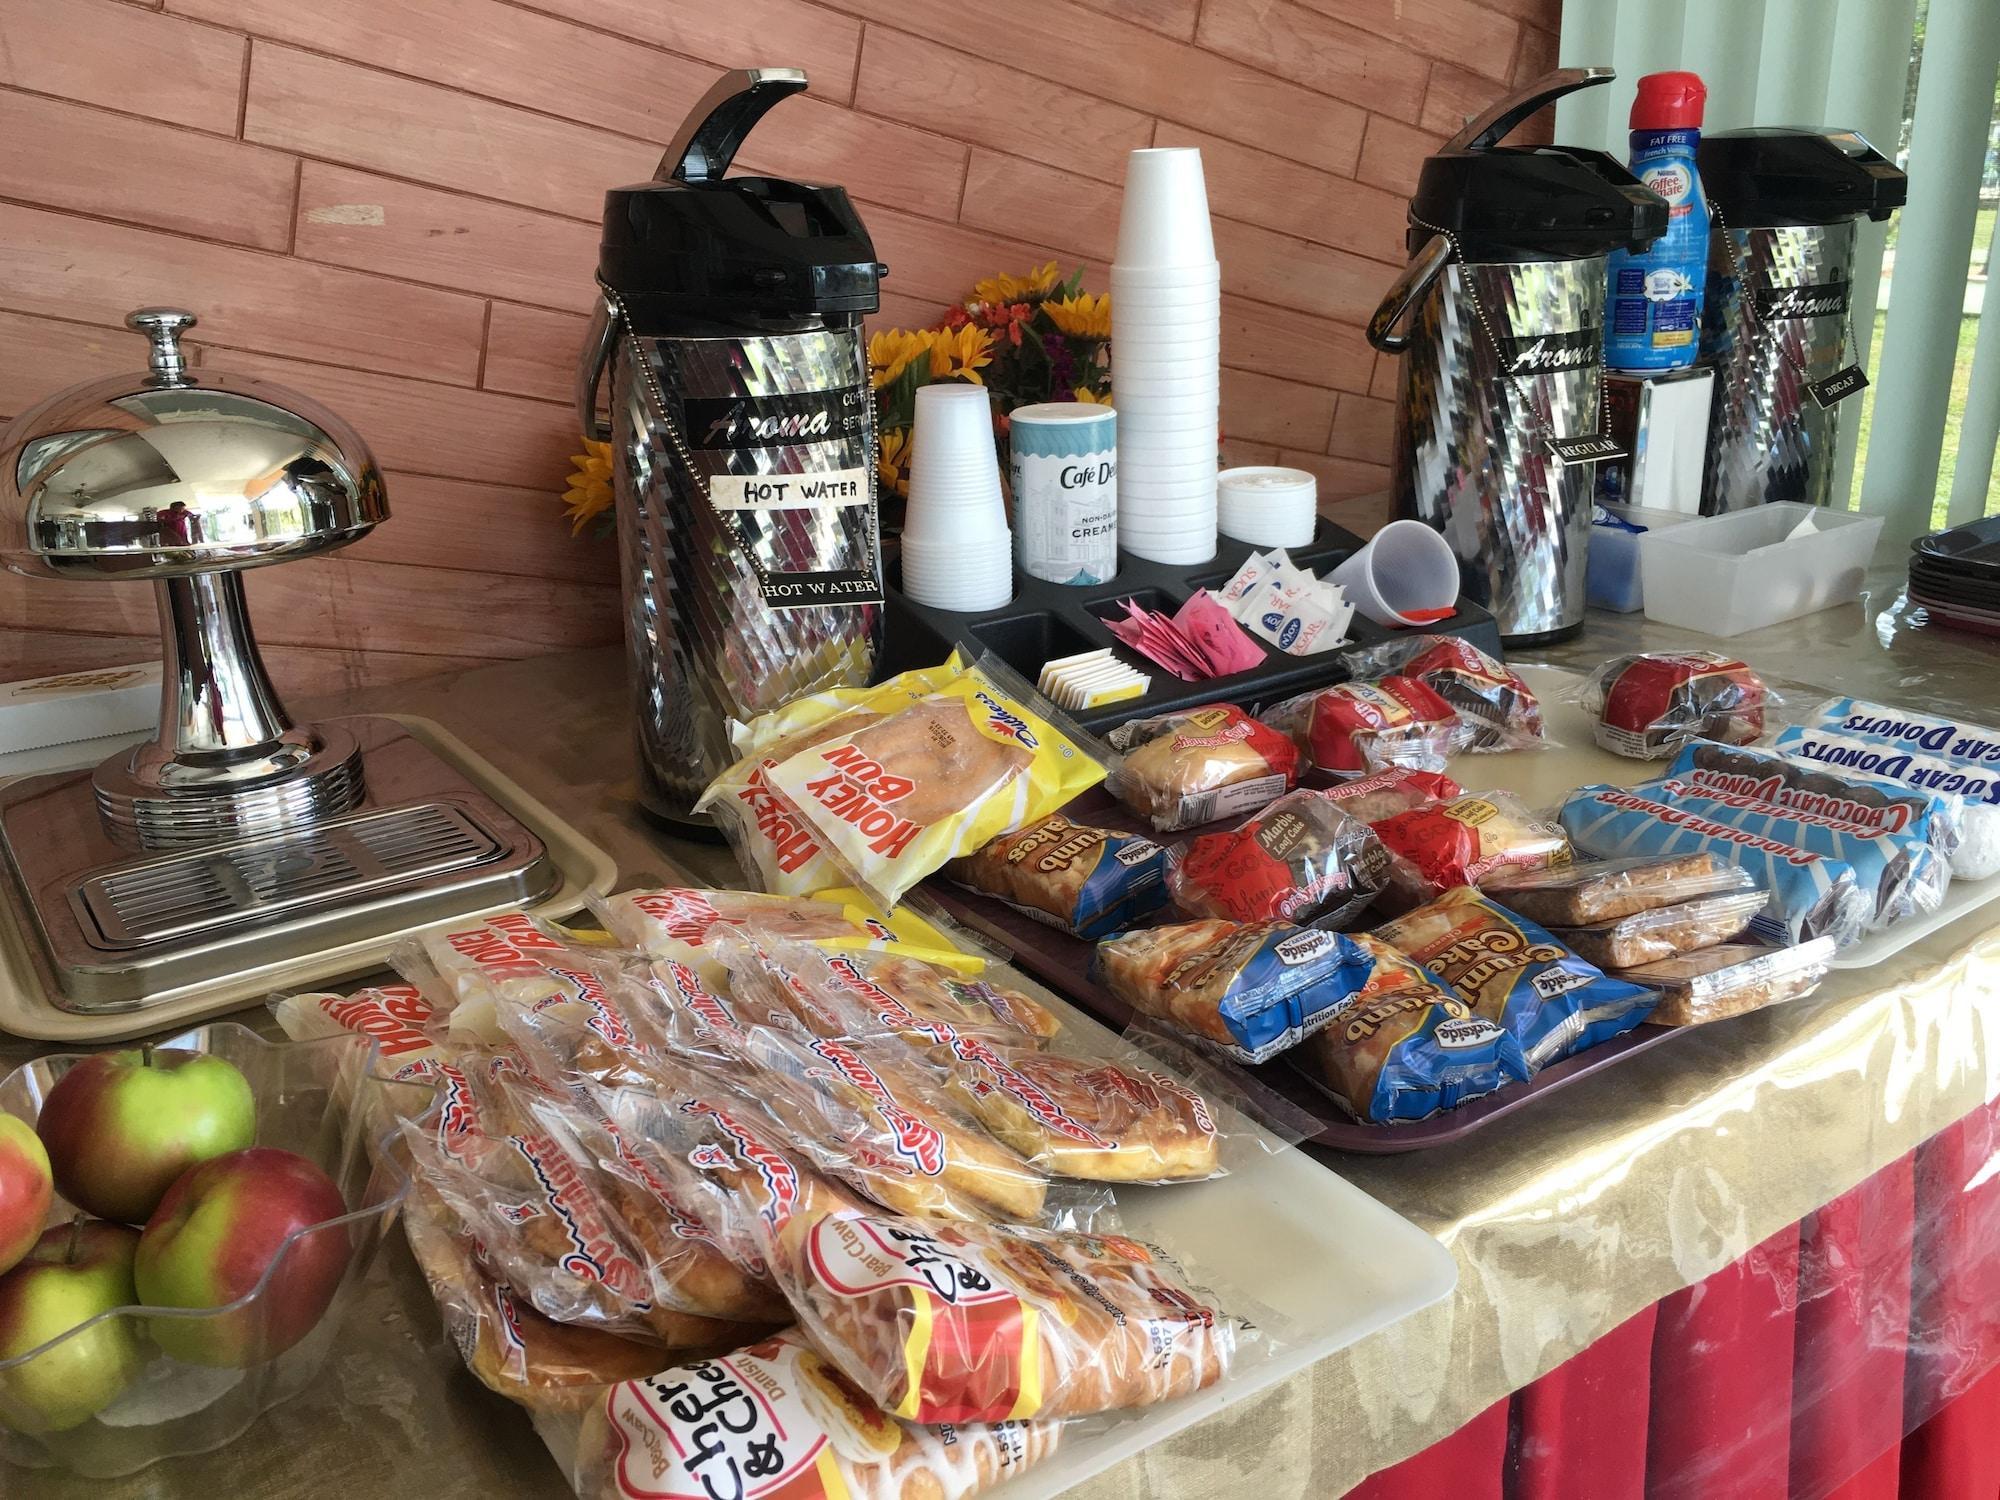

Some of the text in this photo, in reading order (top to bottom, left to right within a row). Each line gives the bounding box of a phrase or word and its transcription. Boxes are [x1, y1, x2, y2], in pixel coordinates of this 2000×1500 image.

[1650, 135, 1687, 147] FAT FREE
[1510, 338, 1594, 369] Aroma
[1825, 376, 1854, 396] DECAF
[703, 401, 832, 445] Aroma
[1559, 440, 1619, 457] REGULAR
[744, 481, 857, 503] HOT WATER
[1060, 466, 1096, 489] Café
[763, 580, 879, 597] HOT WATER
[975, 691, 1039, 750] Duchess
[1843, 714, 1958, 750] DONUTS
[821, 743, 916, 803] BUN
[1799, 741, 1913, 779] DONUTS
[805, 773, 925, 860] HONEY
[1691, 769, 1911, 835] CHOCOLATE DONUTS
[1260, 812, 1296, 848] Marble
[1273, 820, 1305, 856] Loaf Cake
[1596, 791, 1821, 866] CHOCOLATE DONUTS
[1748, 802, 1883, 840] CHOCOLATE
[1280, 935, 1332, 961] Parkside
[736, 1357, 787, 1402] Danish
[743, 1433, 784, 1478] &
